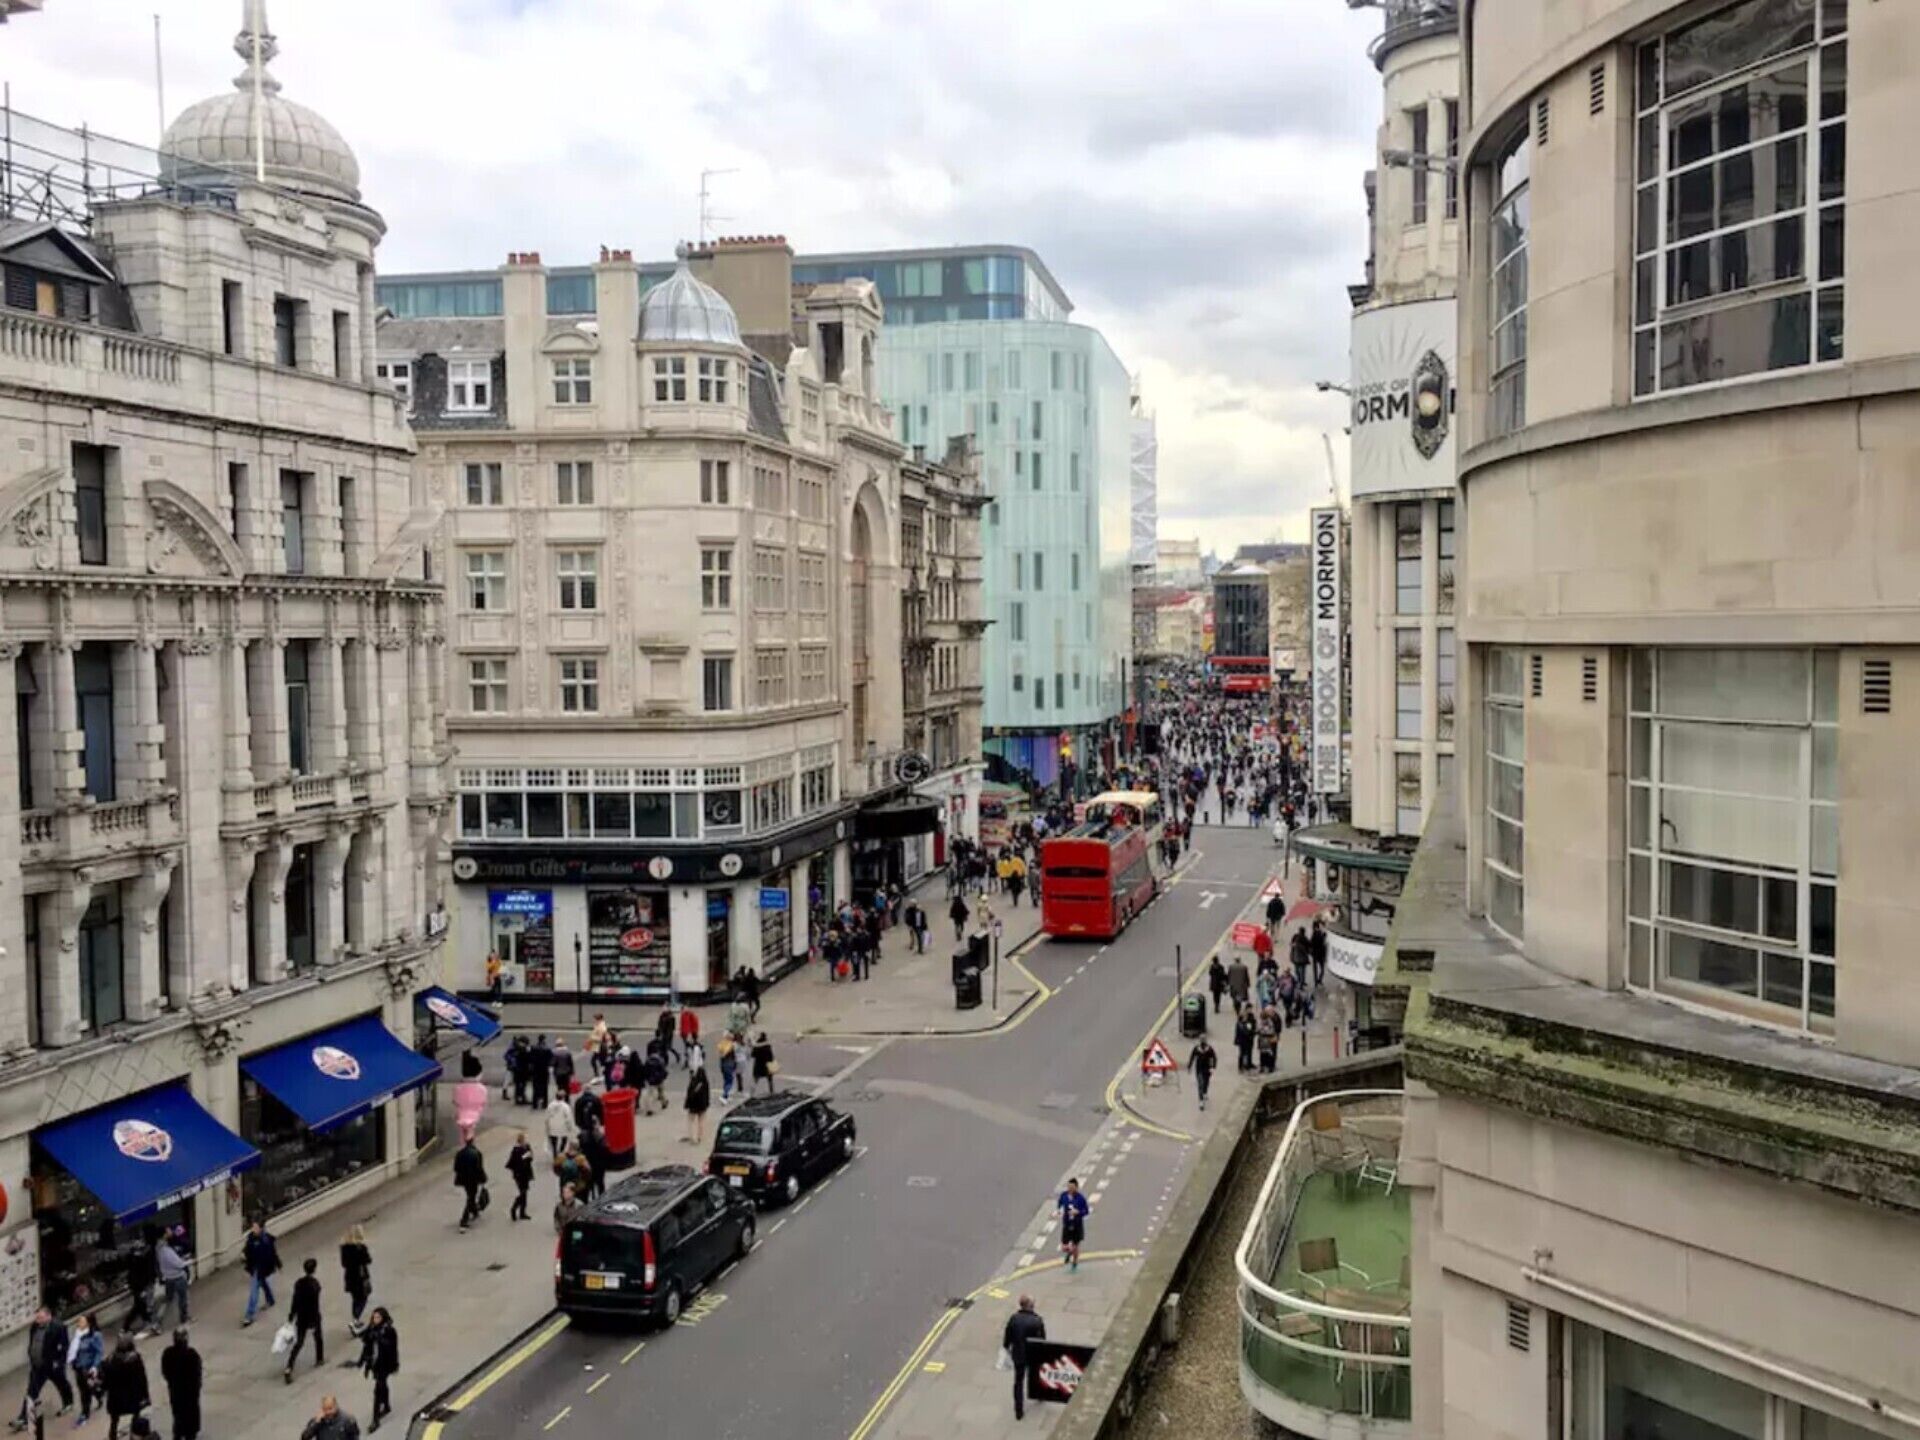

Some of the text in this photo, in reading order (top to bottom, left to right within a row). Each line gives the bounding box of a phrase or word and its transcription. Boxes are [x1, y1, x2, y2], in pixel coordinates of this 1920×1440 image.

[1317, 513, 1336, 789] THE BOOK OF MORMON
[529, 858, 567, 877] Gifts
